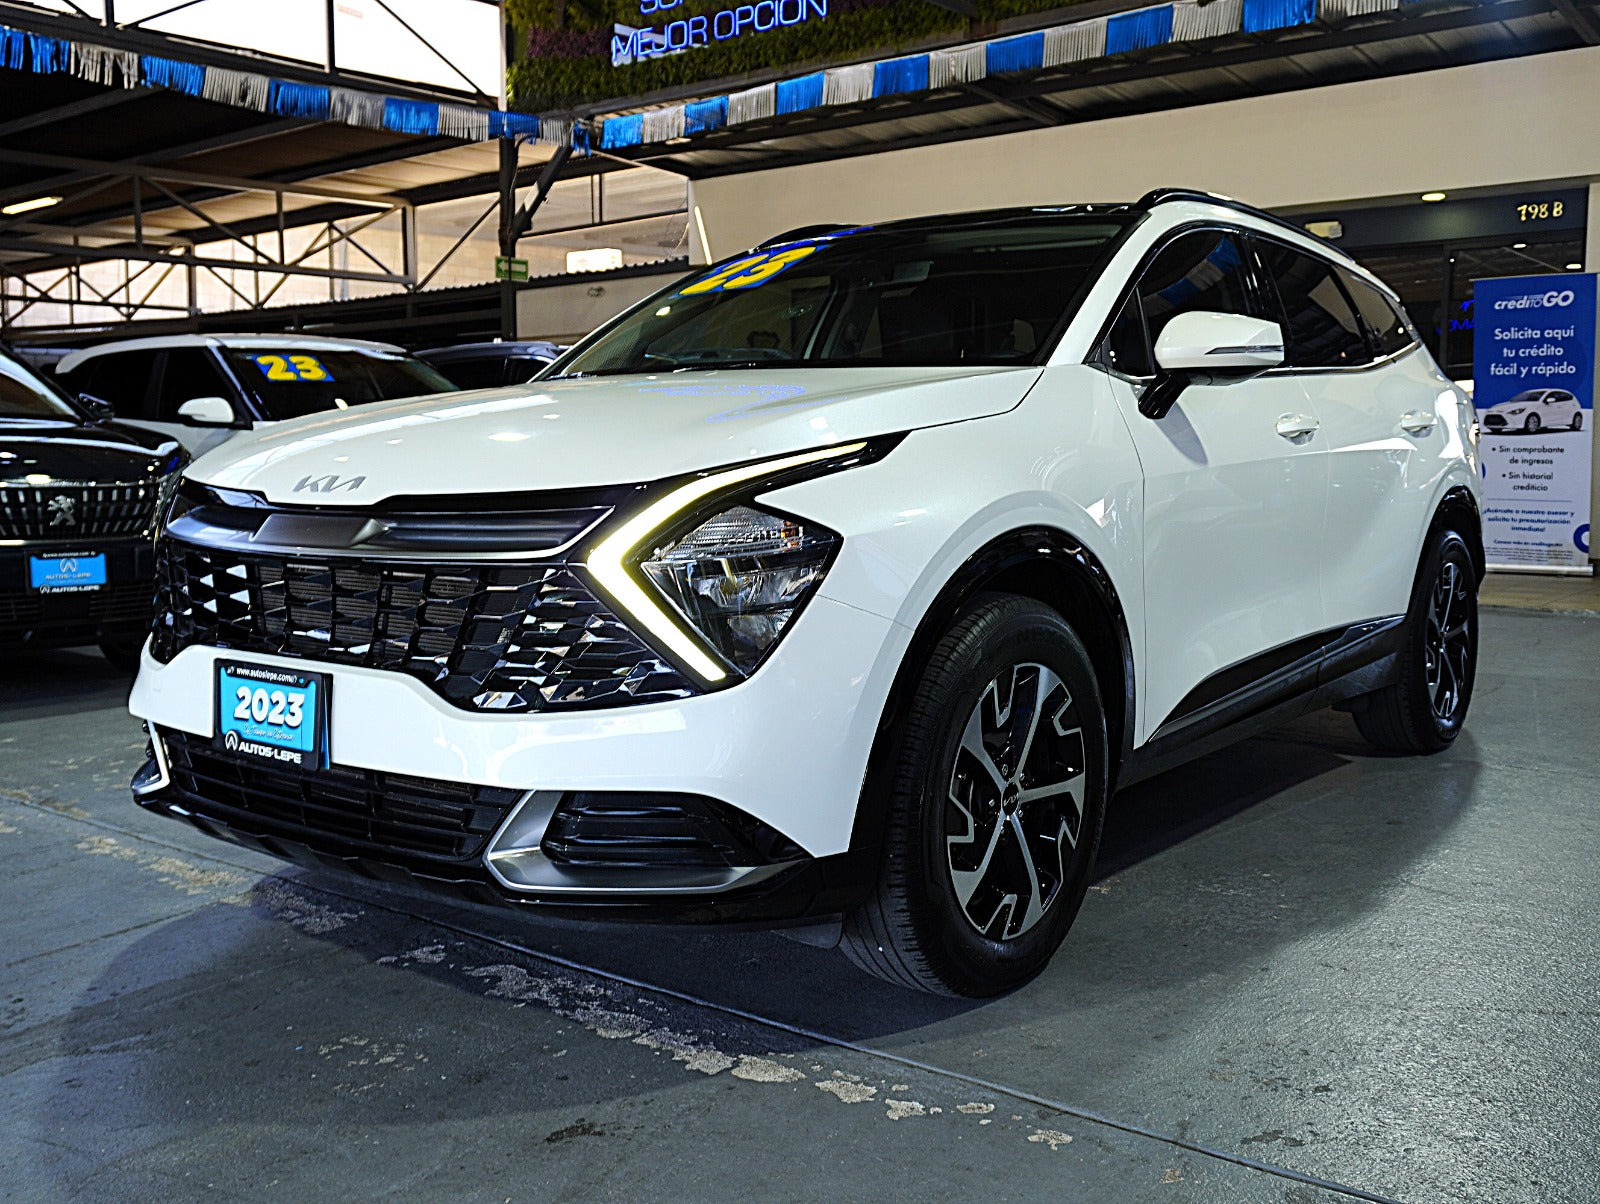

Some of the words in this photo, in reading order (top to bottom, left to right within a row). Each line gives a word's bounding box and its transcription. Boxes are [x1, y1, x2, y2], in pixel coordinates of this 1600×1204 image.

[611, 16, 708, 62] MEJOR
[1516, 203, 1549, 221] 798
[1552, 201, 1564, 217] B
[1494, 327, 1541, 340] Solicita
[1544, 325, 1574, 341] aquí
[1503, 346, 1516, 357] tu
[1519, 344, 1564, 357] crédito
[256, 355, 327, 381] 23
[1490, 362, 1517, 375] fácil
[1520, 366, 1529, 378] y
[1532, 361, 1576, 377] rápido
[1499, 445, 1511, 453] Sin
[1512, 445, 1565, 454] comprobante
[1521, 458, 1554, 466] ingresos
[292, 474, 367, 493] KIA
[1522, 472, 1554, 480] historial
[1512, 483, 1549, 491] crediticio
[233, 685, 305, 729] 2023
